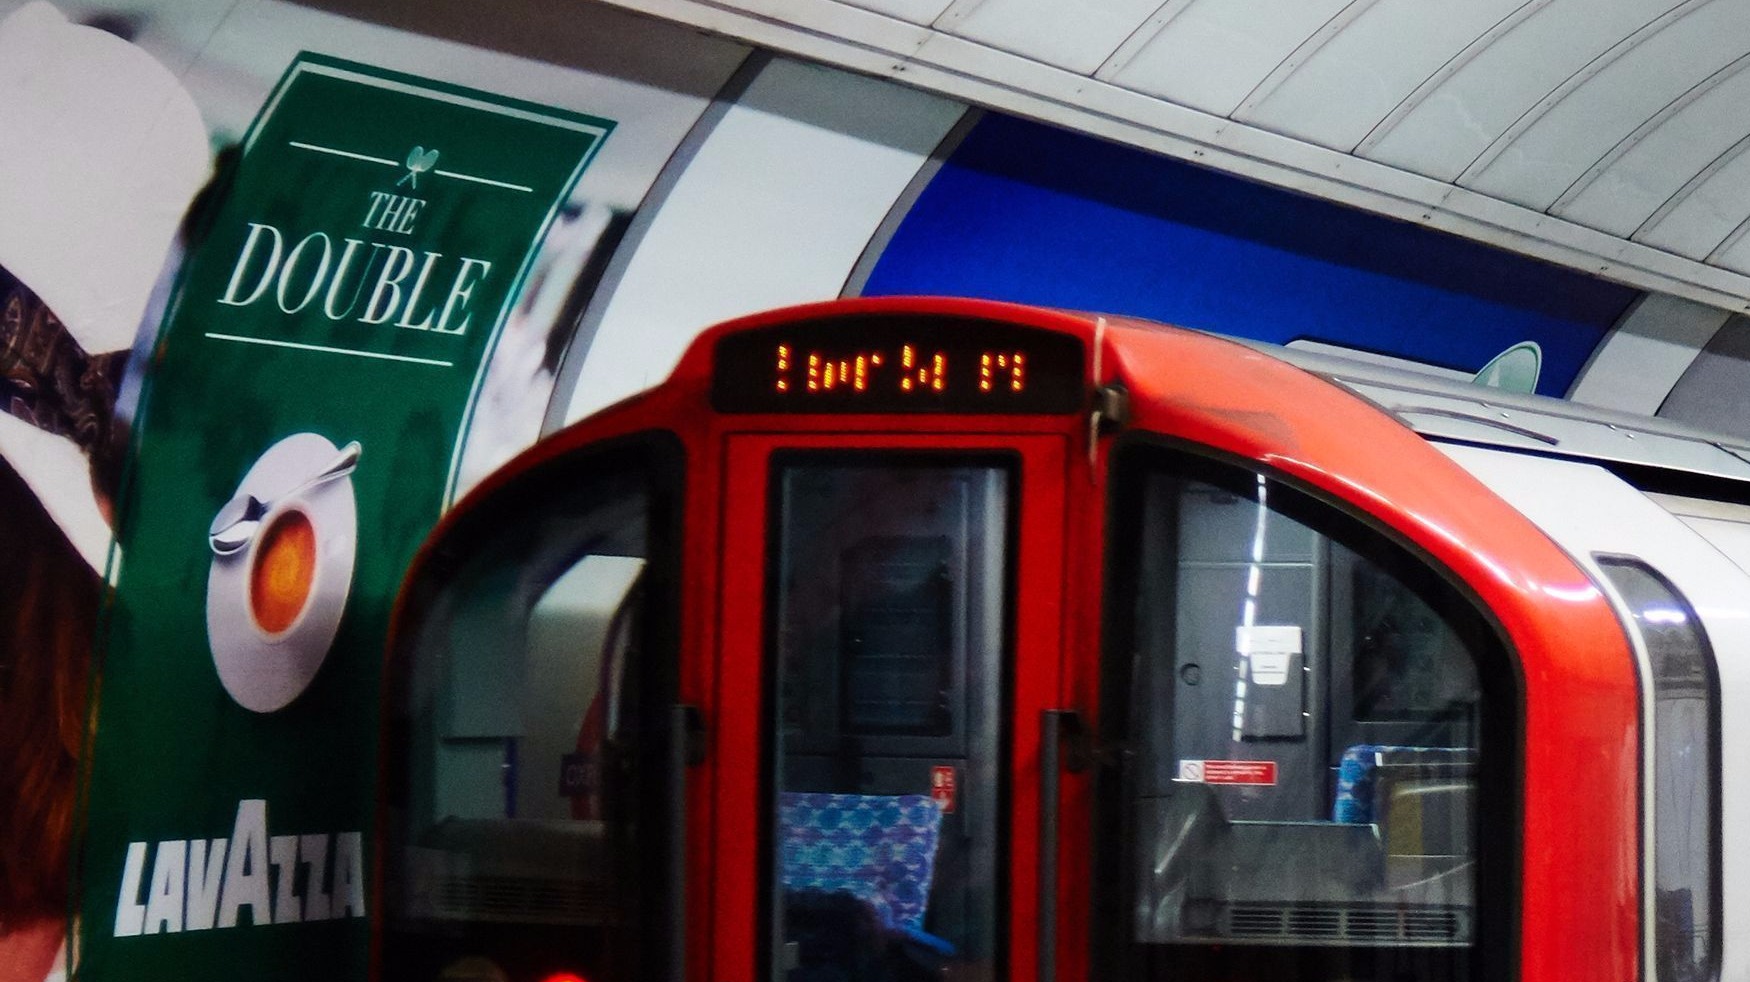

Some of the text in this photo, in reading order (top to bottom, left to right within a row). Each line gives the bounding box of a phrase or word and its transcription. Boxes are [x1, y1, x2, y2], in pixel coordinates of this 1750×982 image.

[362, 190, 427, 235] THE
[217, 222, 492, 336] DOUBLE
[113, 799, 366, 938] LAVAZZA
